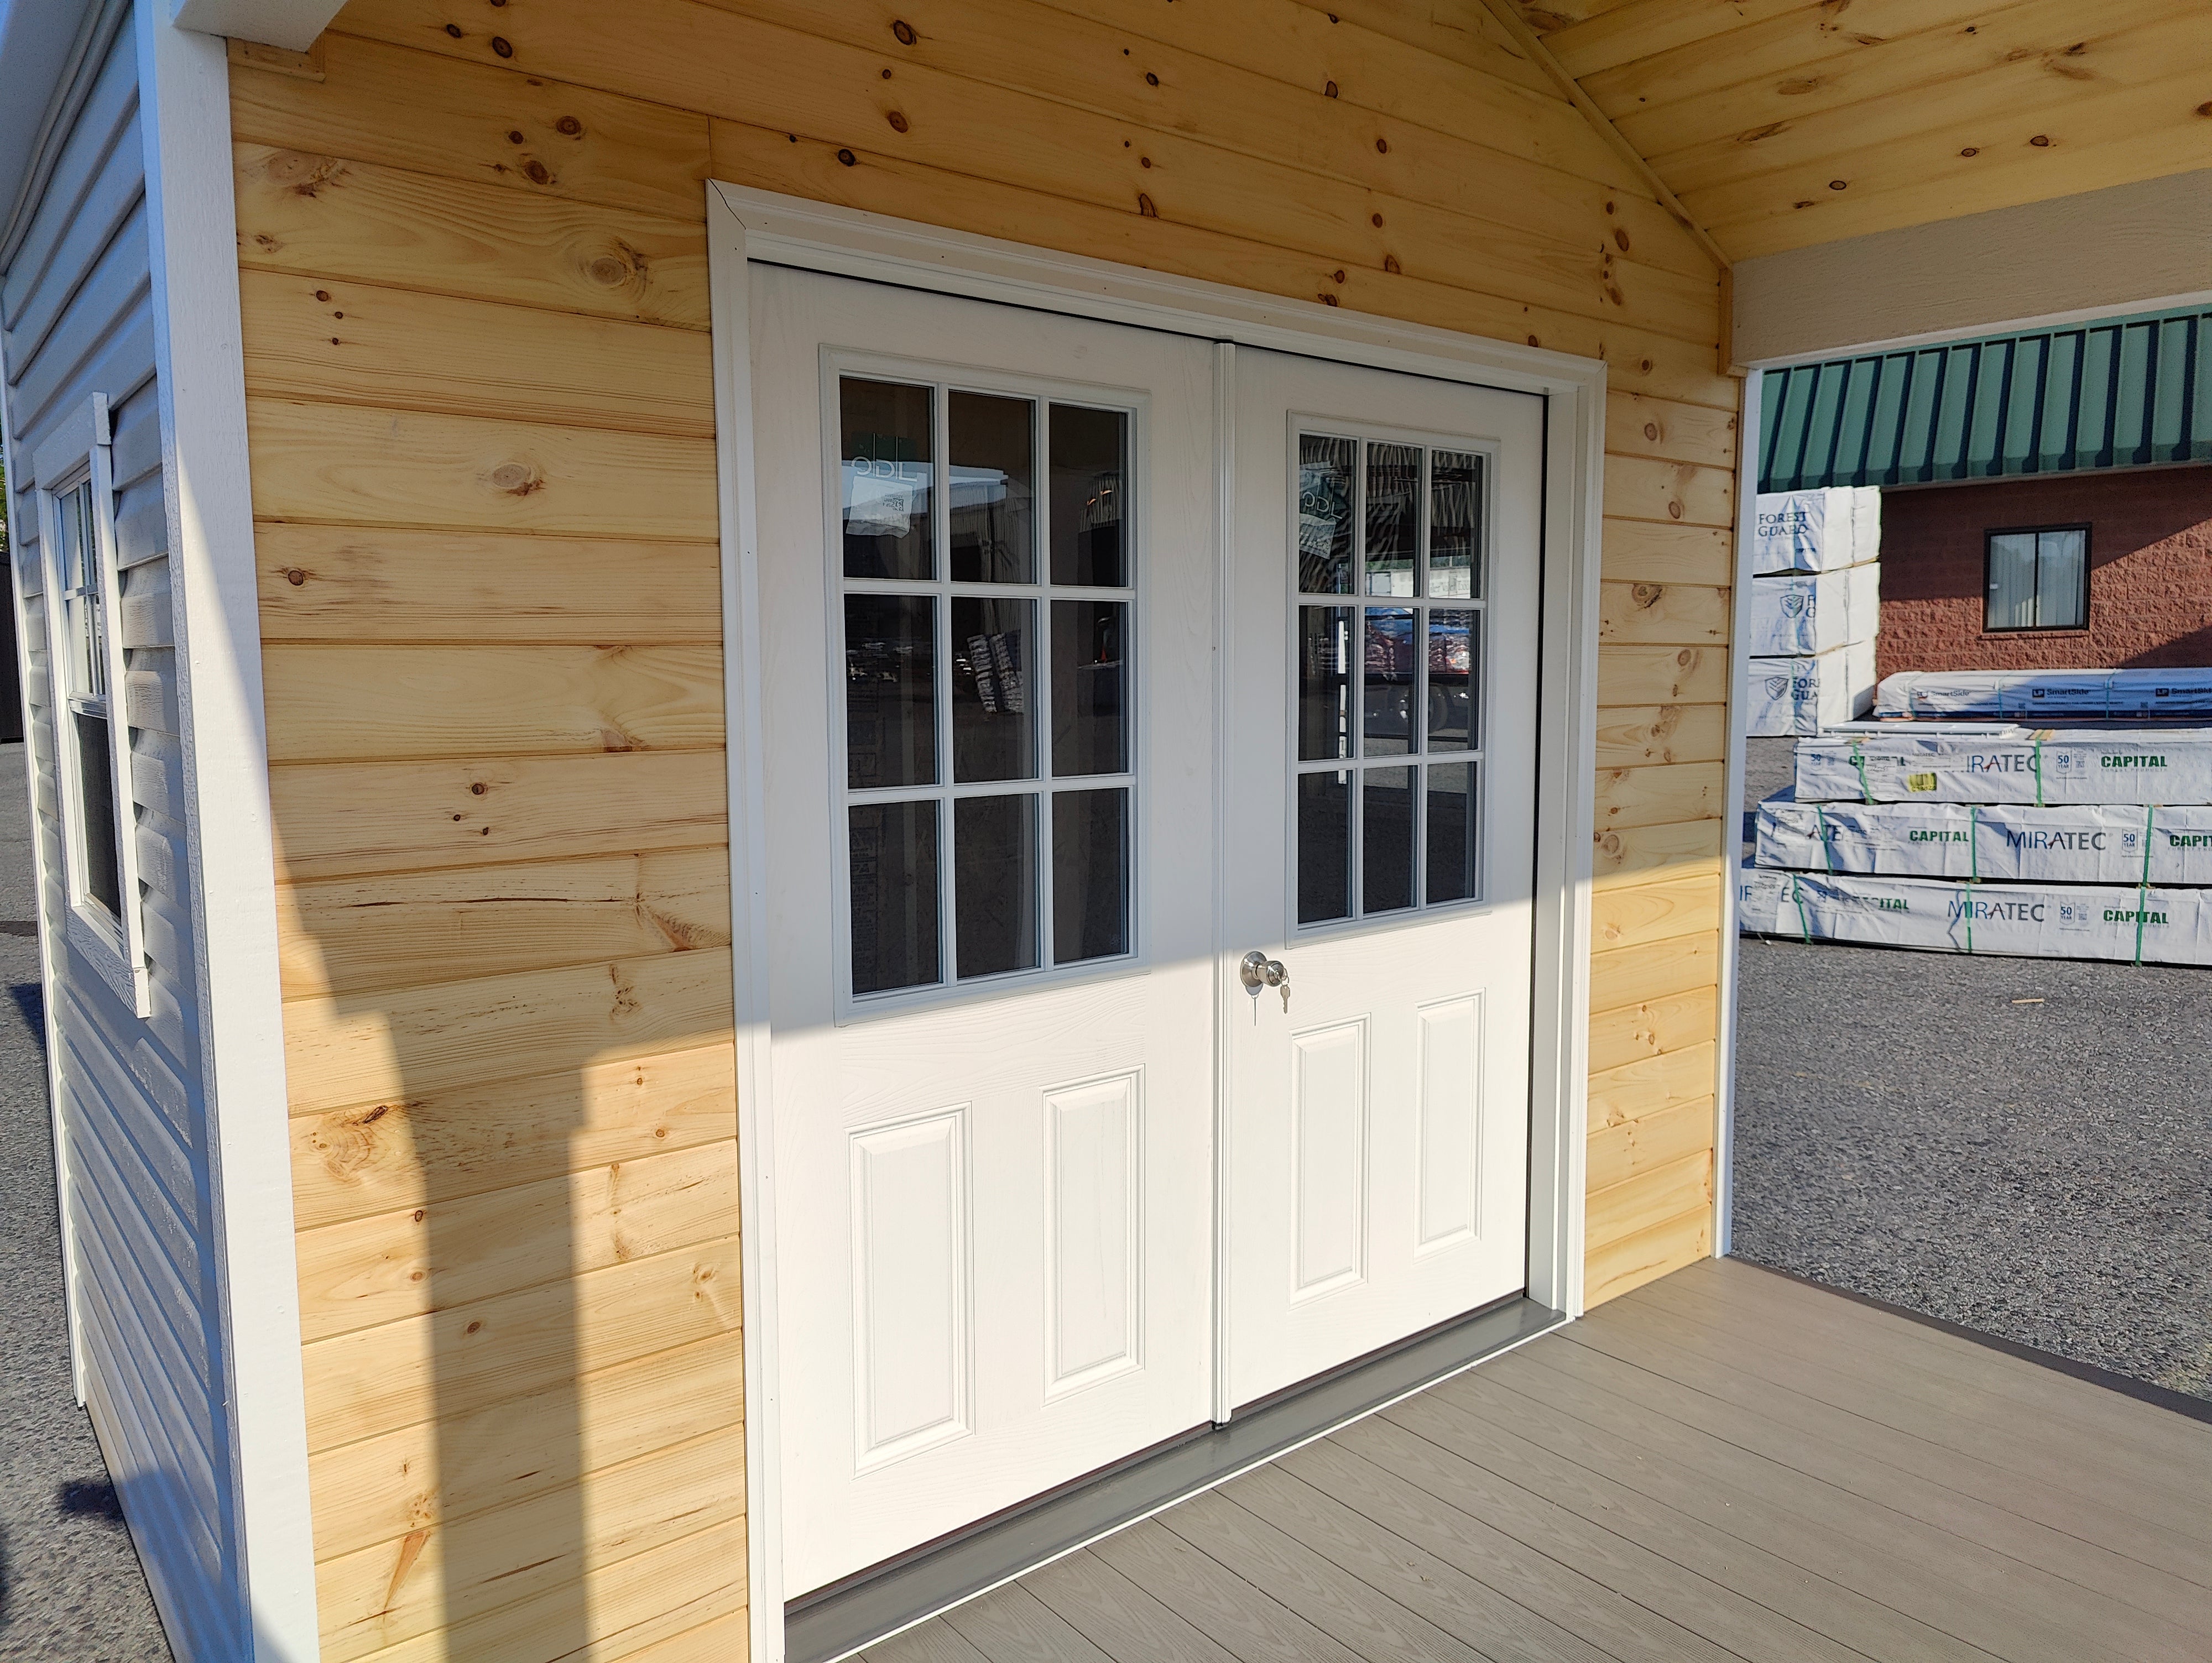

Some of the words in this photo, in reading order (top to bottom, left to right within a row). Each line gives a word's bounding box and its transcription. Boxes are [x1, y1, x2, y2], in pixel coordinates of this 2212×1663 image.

[851, 456, 917, 482] ODL
[1302, 491, 1343, 519] ODL
[1759, 512, 1809, 524] FOREST
[1759, 525, 1808, 536] GUARD
[1967, 755, 2037, 773] IRATEC
[2058, 755, 2069, 764] 50
[2101, 756, 2168, 767] CAPITAL
[1910, 830, 1969, 842] CAPITAL
[2006, 829, 2106, 850] MIRATEC
[2124, 834, 2135, 843] 50
[1948, 901, 2044, 922] MIRATEC
[2060, 907, 2072, 915] 50
[2103, 909, 2169, 924] CAPITAL
